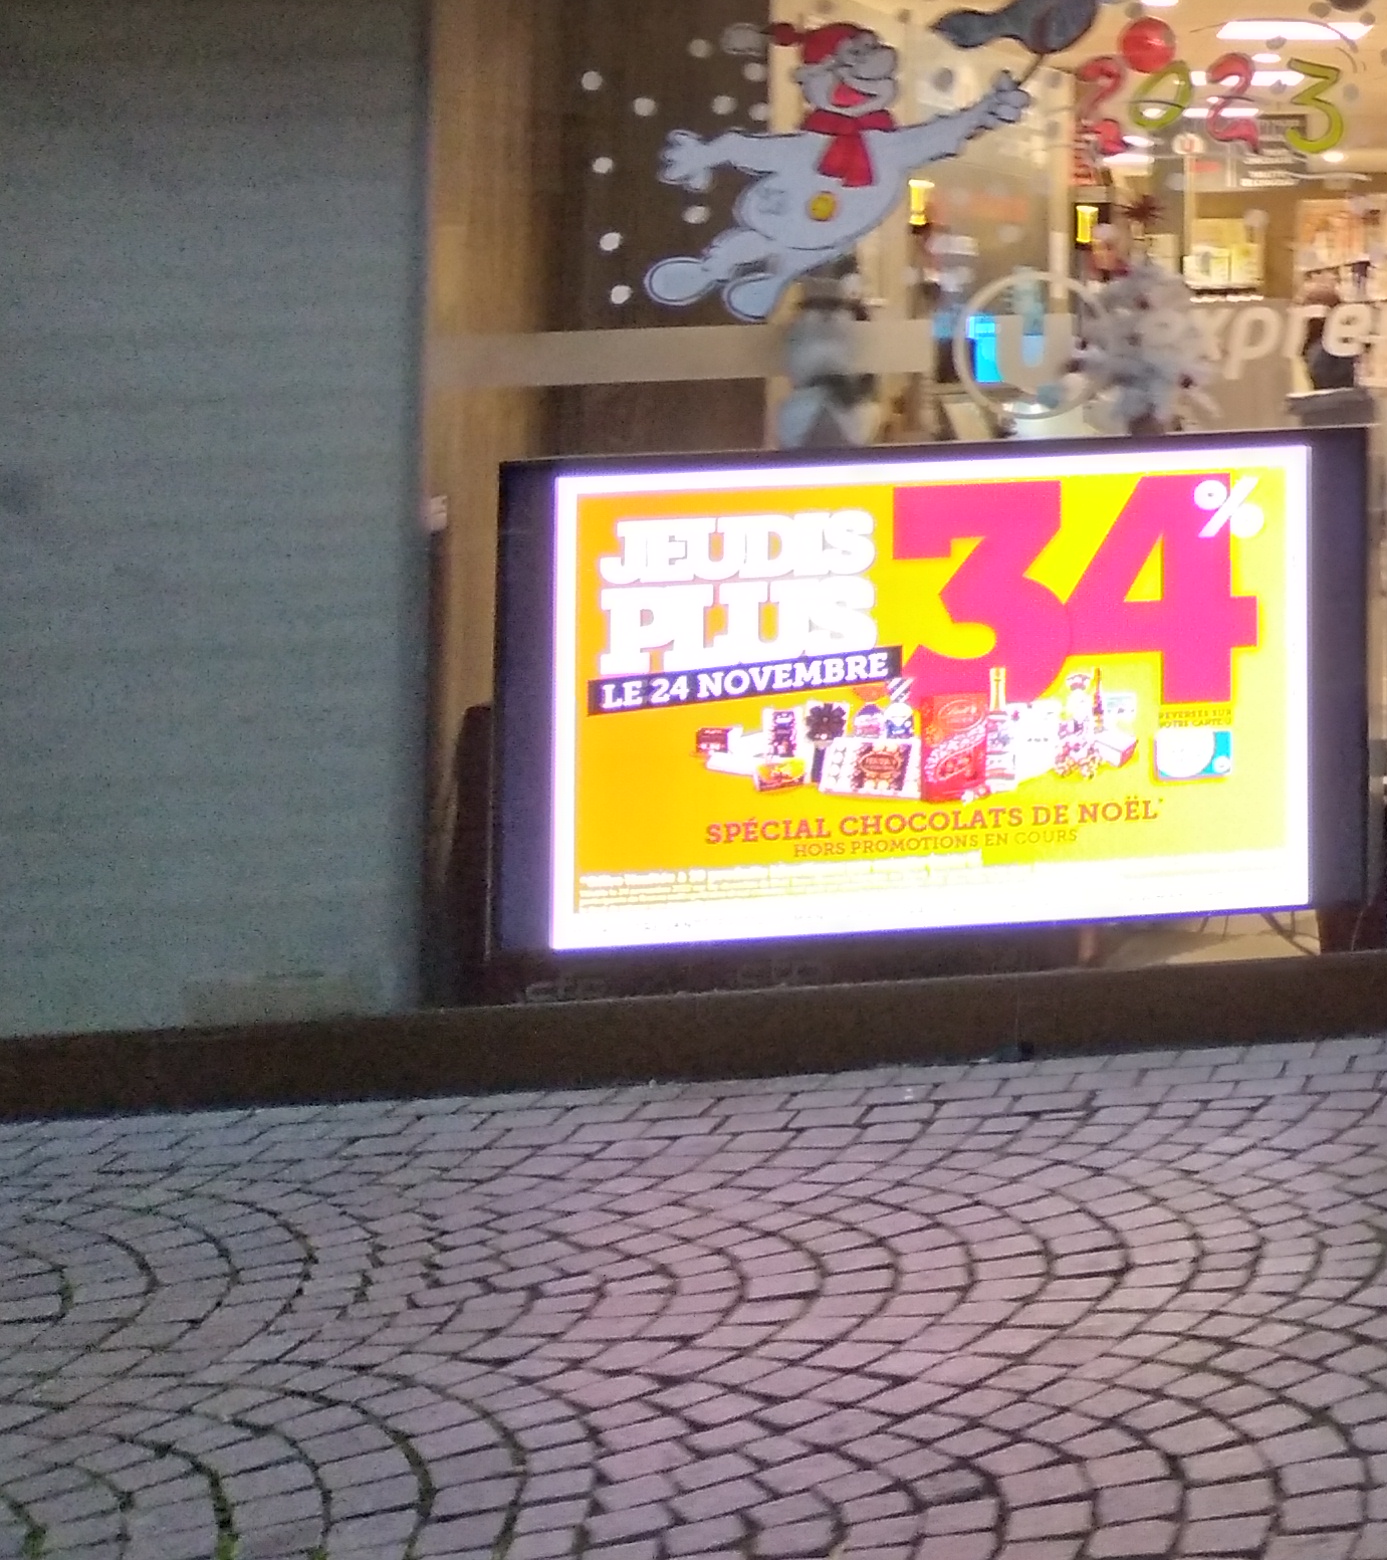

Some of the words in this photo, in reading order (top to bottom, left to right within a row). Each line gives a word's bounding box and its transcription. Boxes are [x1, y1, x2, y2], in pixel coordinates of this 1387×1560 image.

[1074, 52, 1343, 153] 2023
[600, 509, 876, 584] JEUDIS
[600, 575, 877, 675] PLUS
[602, 680, 642, 710] LE
[649, 675, 690, 704] 24
[697, 652, 889, 698] NOVEMBRE
[706, 816, 831, 845] SPÉCIAL
[841, 807, 1024, 837] CHOCOLATS
[1032, 803, 1069, 826] DE
[793, 841, 846, 859] HORS
[851, 833, 979, 855] PROMOTIONS
[984, 831, 1010, 846] EN
[1015, 827, 1078, 846] COURS
